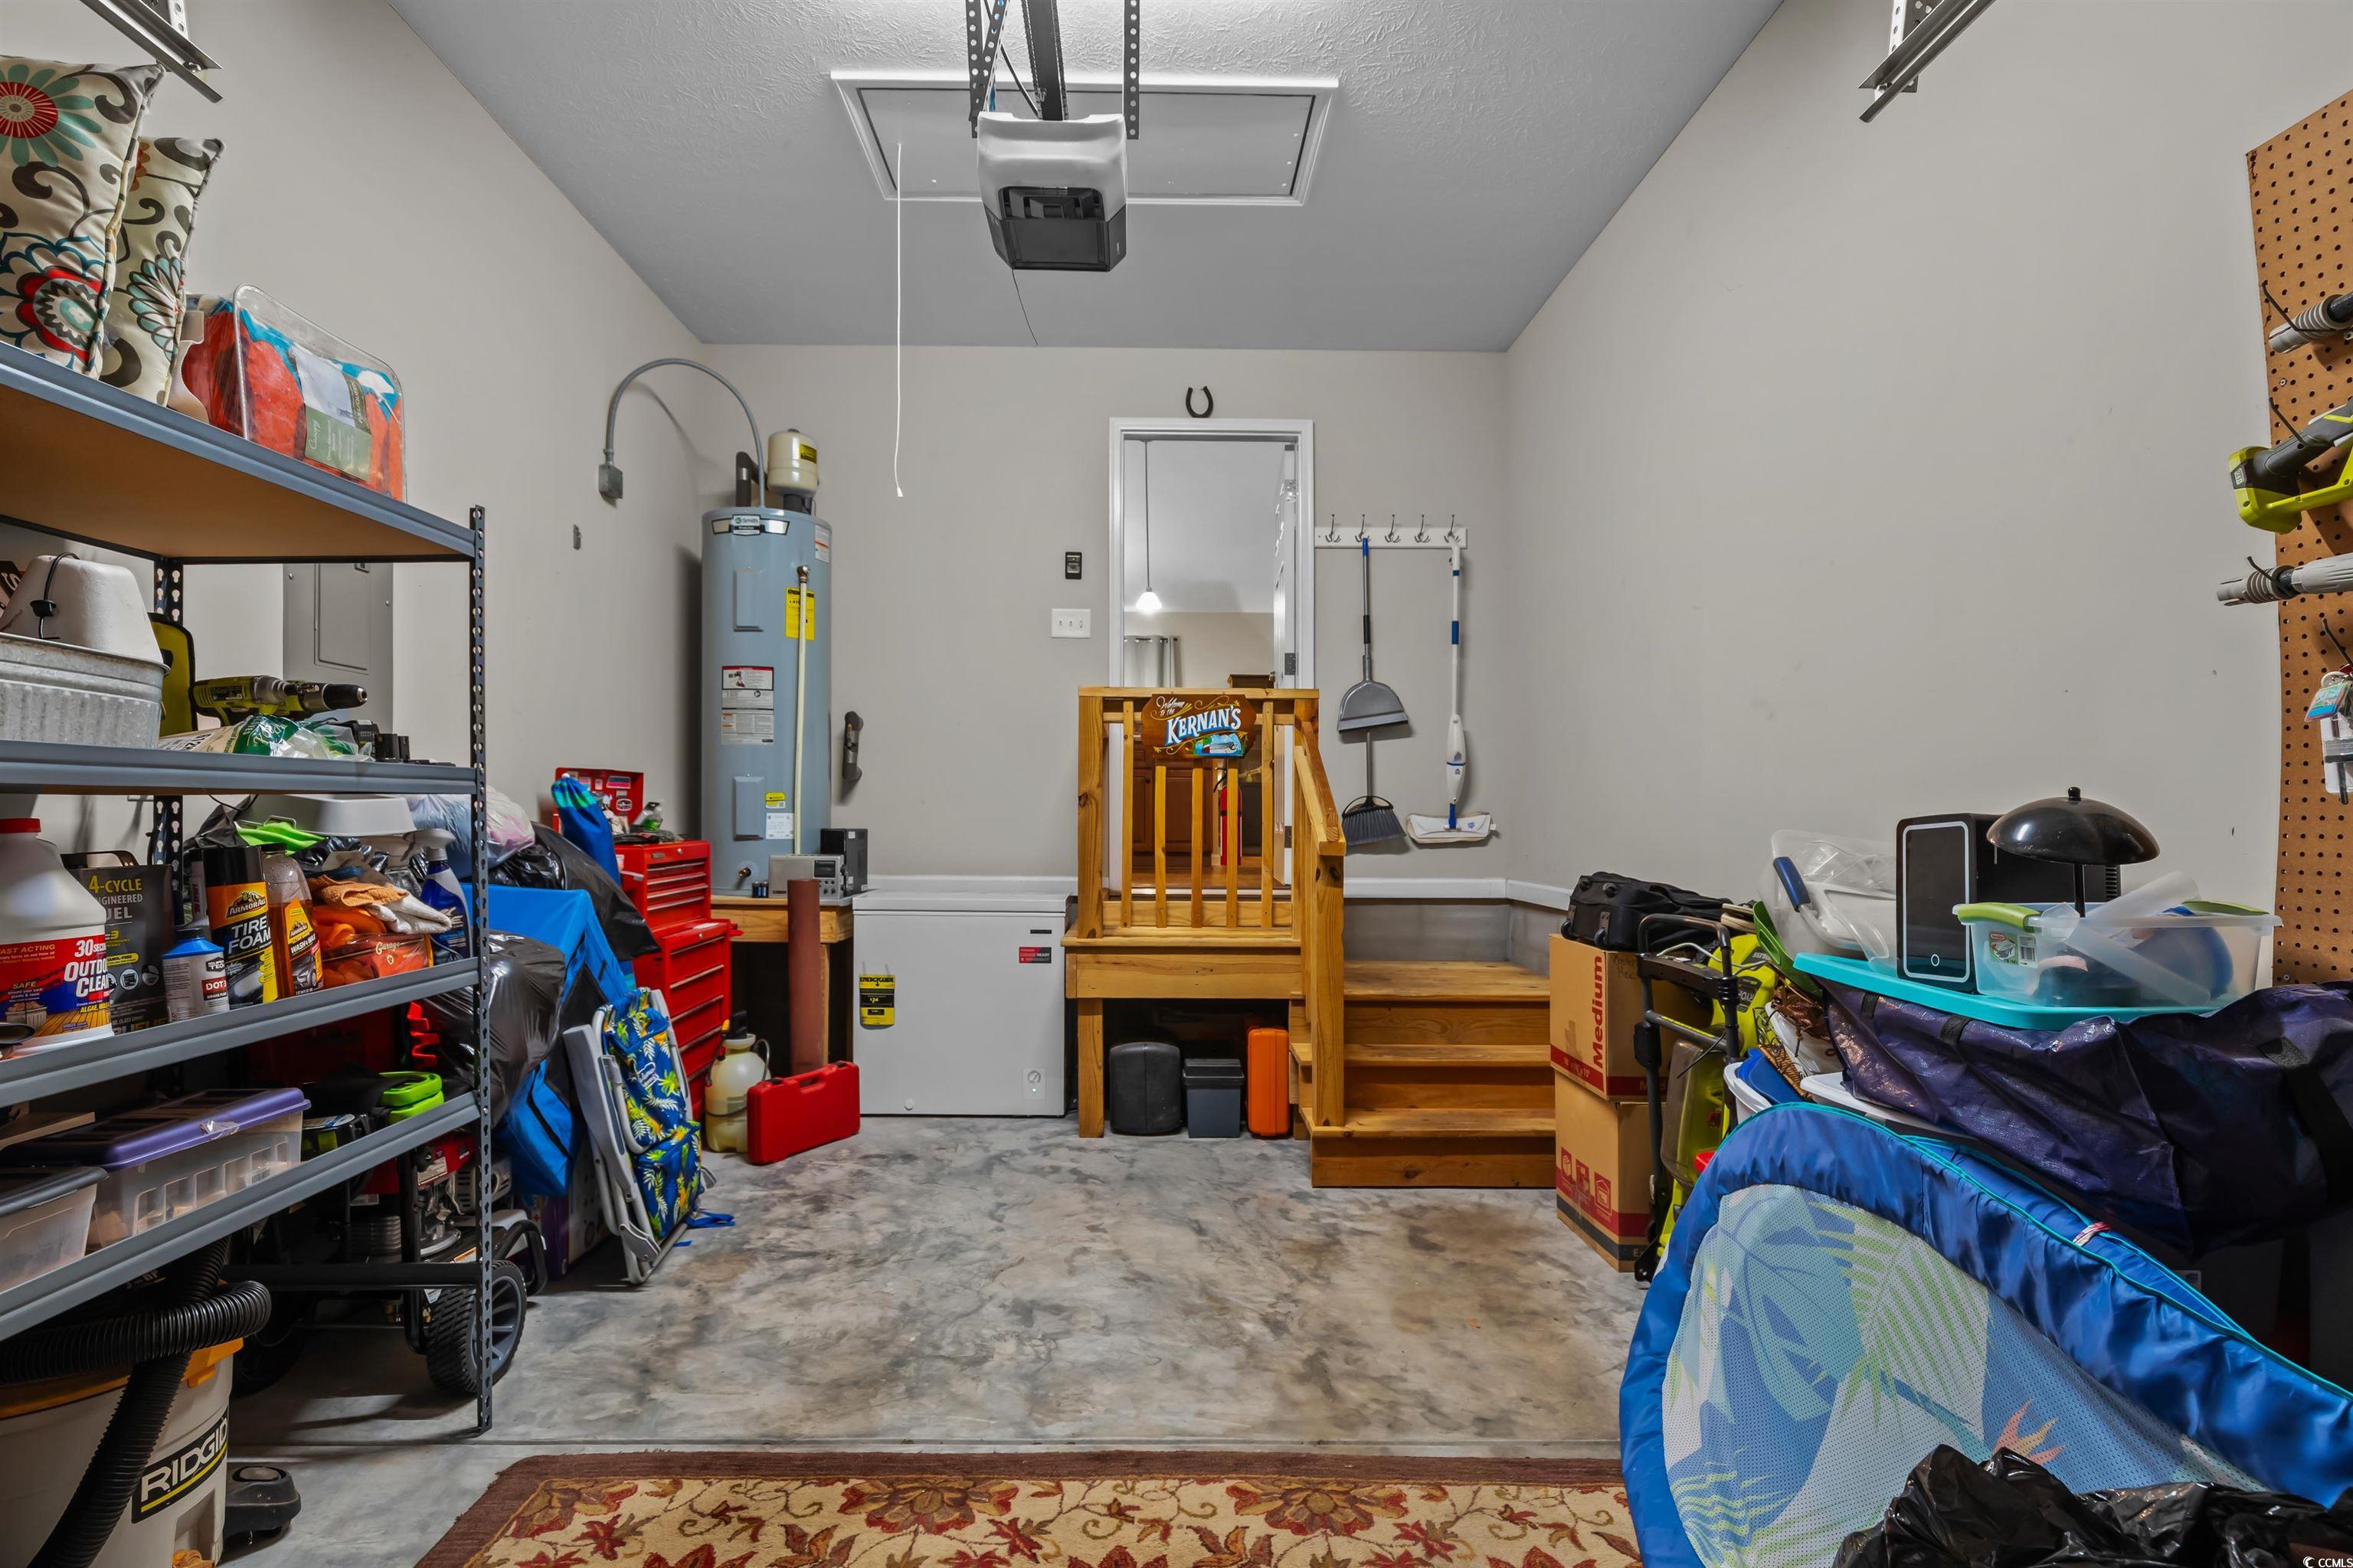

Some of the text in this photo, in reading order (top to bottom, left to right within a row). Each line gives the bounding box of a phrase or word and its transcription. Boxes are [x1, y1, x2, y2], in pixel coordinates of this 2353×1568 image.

[1156, 696, 1185, 710] Welcome
[1165, 705, 1242, 746] KERNAN'S
[89, 875, 142, 894] 4-CYCLE
[97, 893, 143, 905] NGINEERED
[106, 907, 133, 919] UEL
[231, 915, 267, 938] TIRE
[20, 944, 56, 953] ACTING
[74, 938, 93, 957] 30
[228, 926, 271, 954] FOAM
[375, 941, 400, 955] Garage
[1591, 955, 1604, 1069] Medium
[141, 1417, 227, 1503] RIDGID
